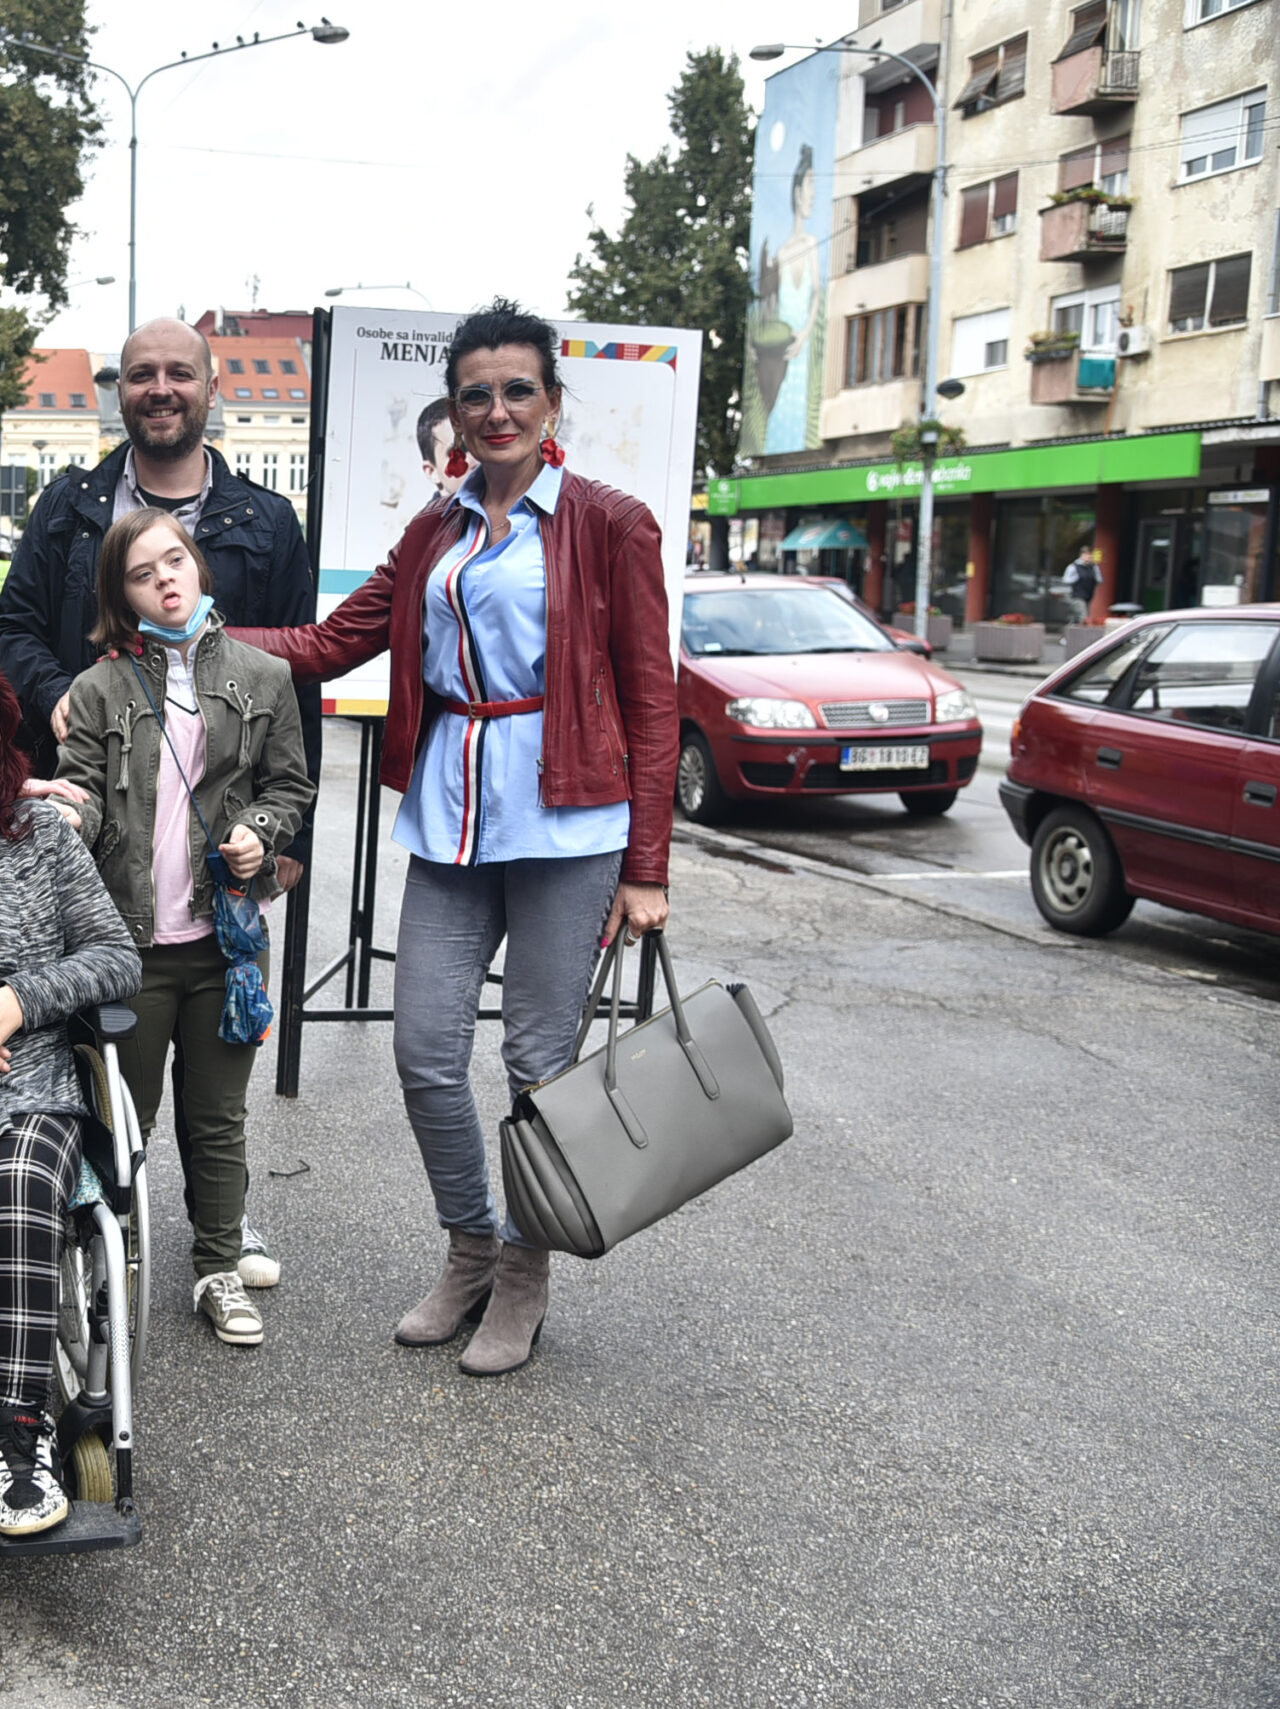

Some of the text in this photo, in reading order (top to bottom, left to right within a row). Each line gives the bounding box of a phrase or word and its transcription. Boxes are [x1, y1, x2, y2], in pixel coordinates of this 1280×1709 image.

[356, 326, 455, 343] Osobe sa invalid
[379, 341, 451, 366] MENJA
